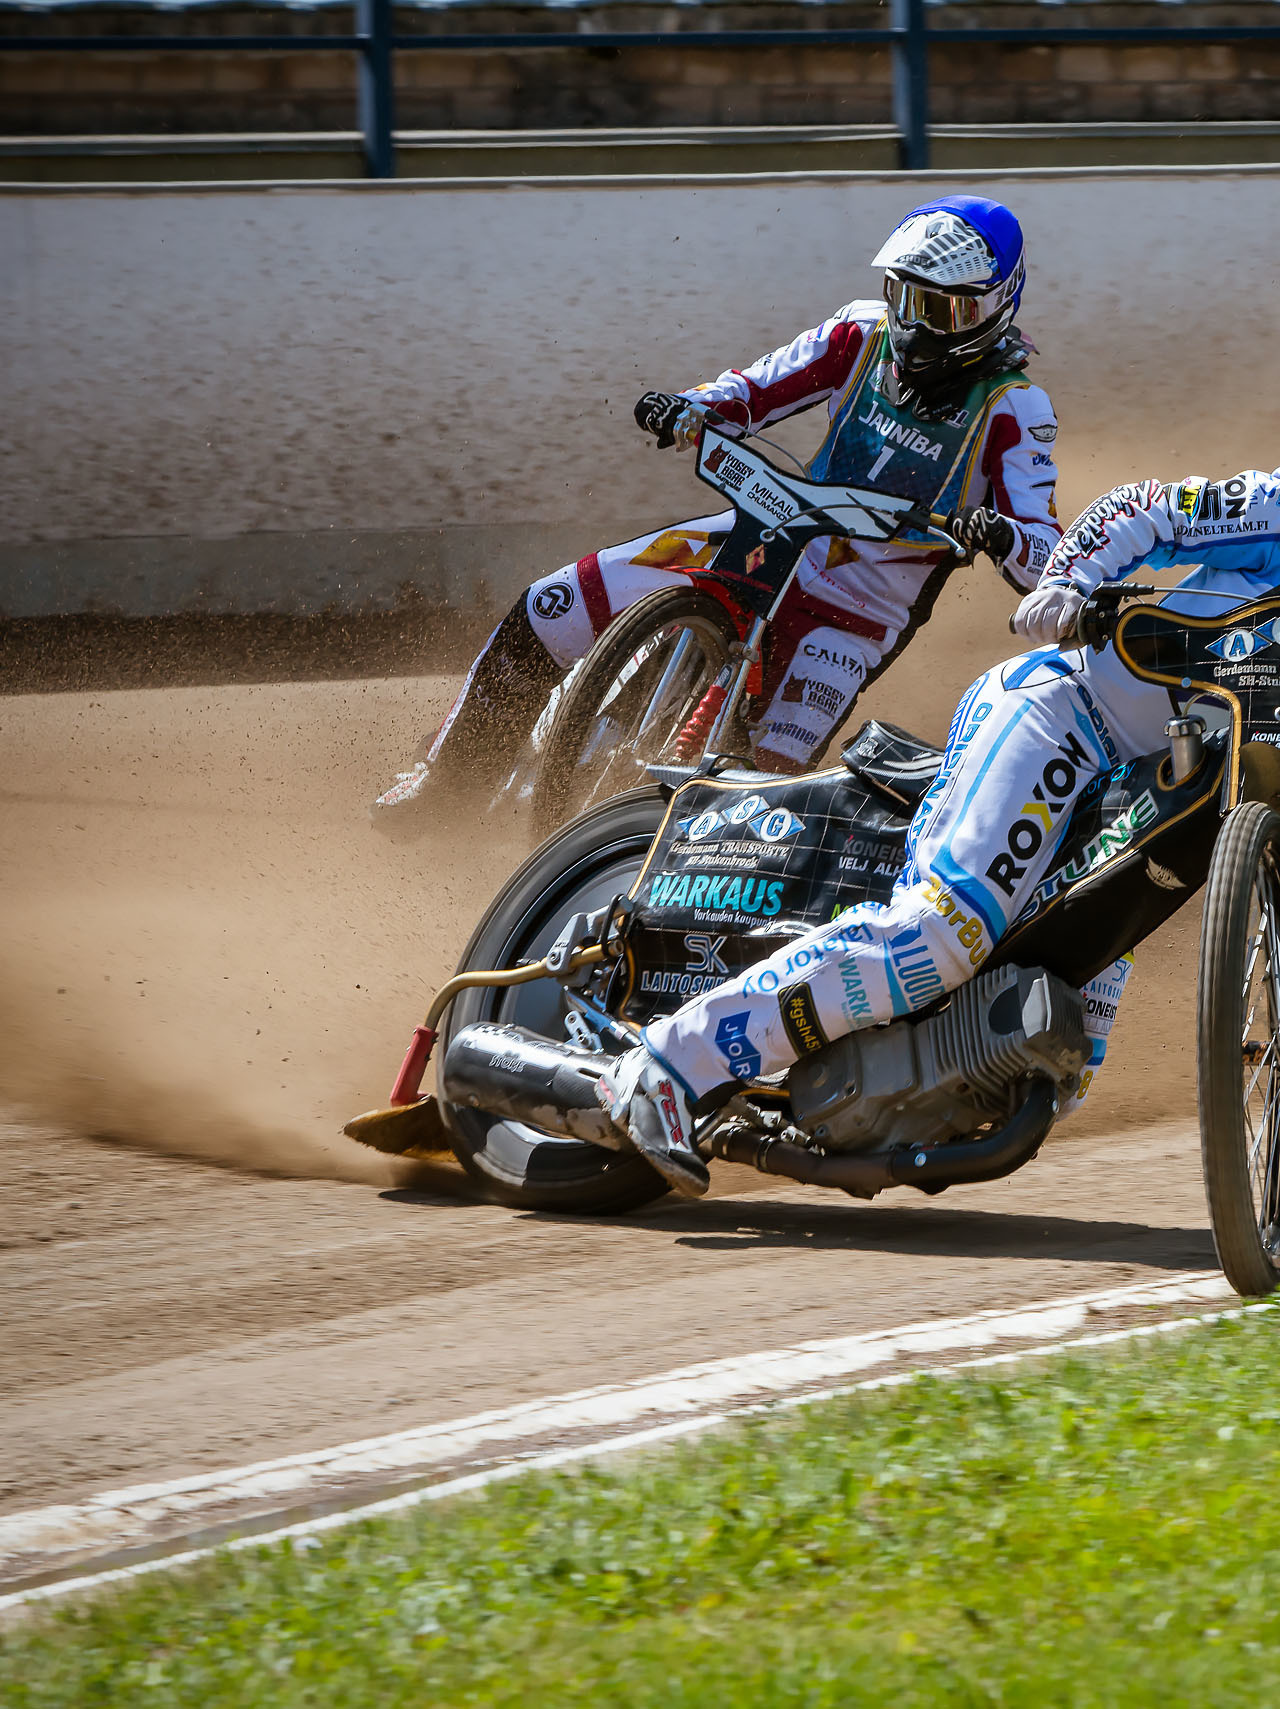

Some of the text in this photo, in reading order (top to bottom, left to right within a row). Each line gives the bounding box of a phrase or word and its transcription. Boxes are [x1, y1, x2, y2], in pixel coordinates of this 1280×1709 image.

[858, 400, 943, 461] JAUNĪBA
[726, 454, 756, 479] YOGGY
[867, 445, 896, 482] 1
[751, 483, 795, 517] MIHAIL
[1213, 663, 1277, 678] Gerdemann
[1109, 761, 1138, 782] Oy
[985, 731, 1097, 898] ROXON
[720, 841, 792, 857] TRANSPORTE
[838, 856, 870, 872] VELJ
[648, 874, 785, 917] WARKAUS
[684, 934, 730, 974] SK
[741, 969, 780, 1000] Oy
